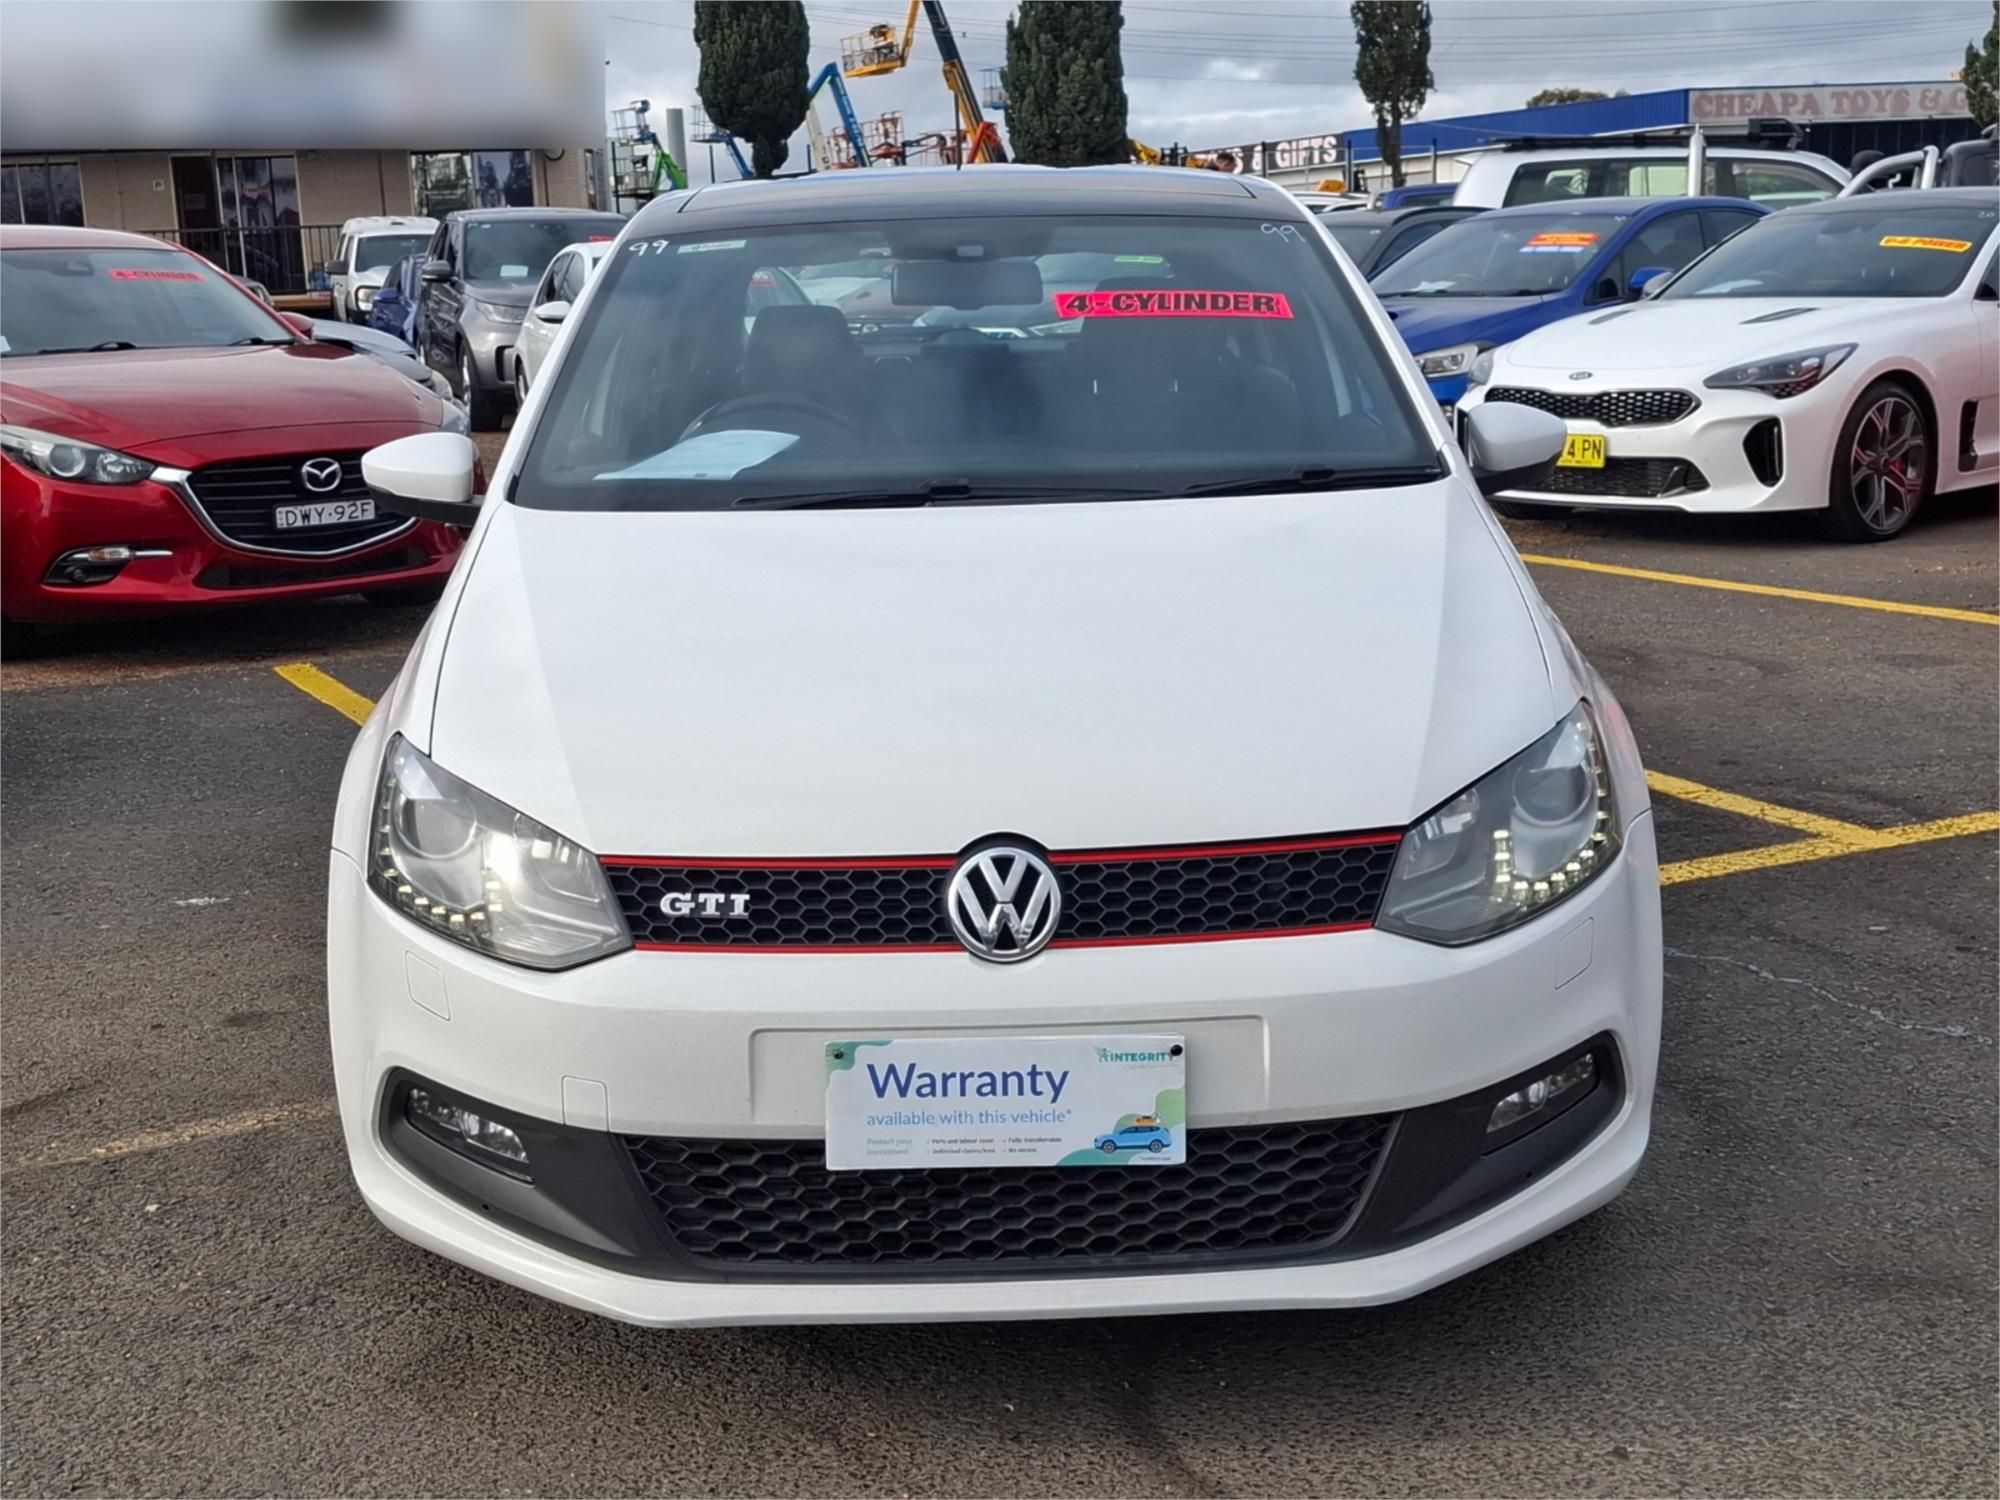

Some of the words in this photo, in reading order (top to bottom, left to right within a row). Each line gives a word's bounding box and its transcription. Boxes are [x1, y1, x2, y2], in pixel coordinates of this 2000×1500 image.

[1693, 91, 1820, 118] CHEAPA
[1830, 89, 1911, 115] TOYS
[1919, 87, 1943, 112] &
[1275, 135, 1338, 168] GIFTS
[628, 239, 670, 256] 99
[659, 891, 750, 918] GTI
[866, 1062, 1070, 1104] Warranty
[866, 1111, 935, 1126] available
[938, 1109, 974, 1125] with
[979, 1108, 1008, 1124] this
